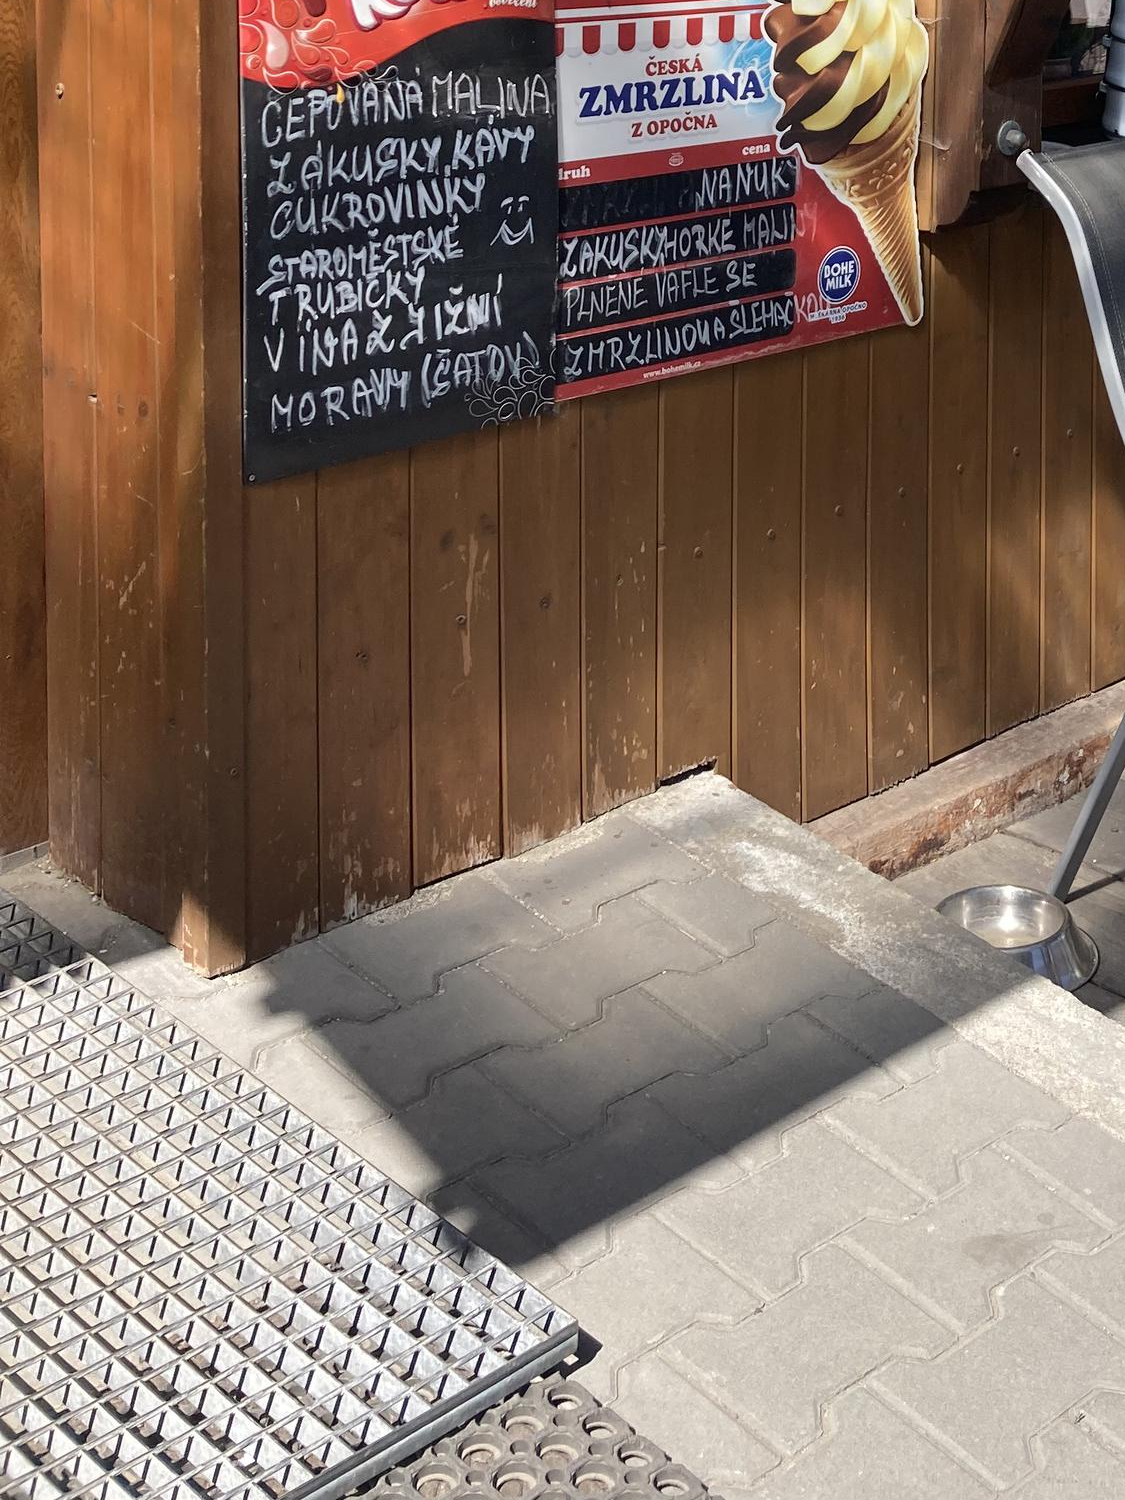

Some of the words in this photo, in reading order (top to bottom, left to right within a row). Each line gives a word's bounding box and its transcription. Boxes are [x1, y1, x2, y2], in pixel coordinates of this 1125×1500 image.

[645, 54, 704, 77] ČESKÁ
[432, 71, 549, 118] MALINA
[579, 70, 765, 118] ZMRZLINA
[631, 122, 643, 138] Z
[646, 111, 719, 136] OPOČNA
[741, 143, 771, 155] cena
[269, 172, 485, 240] CUKROVINKY
[726, 259, 757, 293] SE
[823, 260, 856, 279] BOHE
[825, 273, 852, 292] MILK
[643, 360, 701, 379] www.bohemilk.cz
